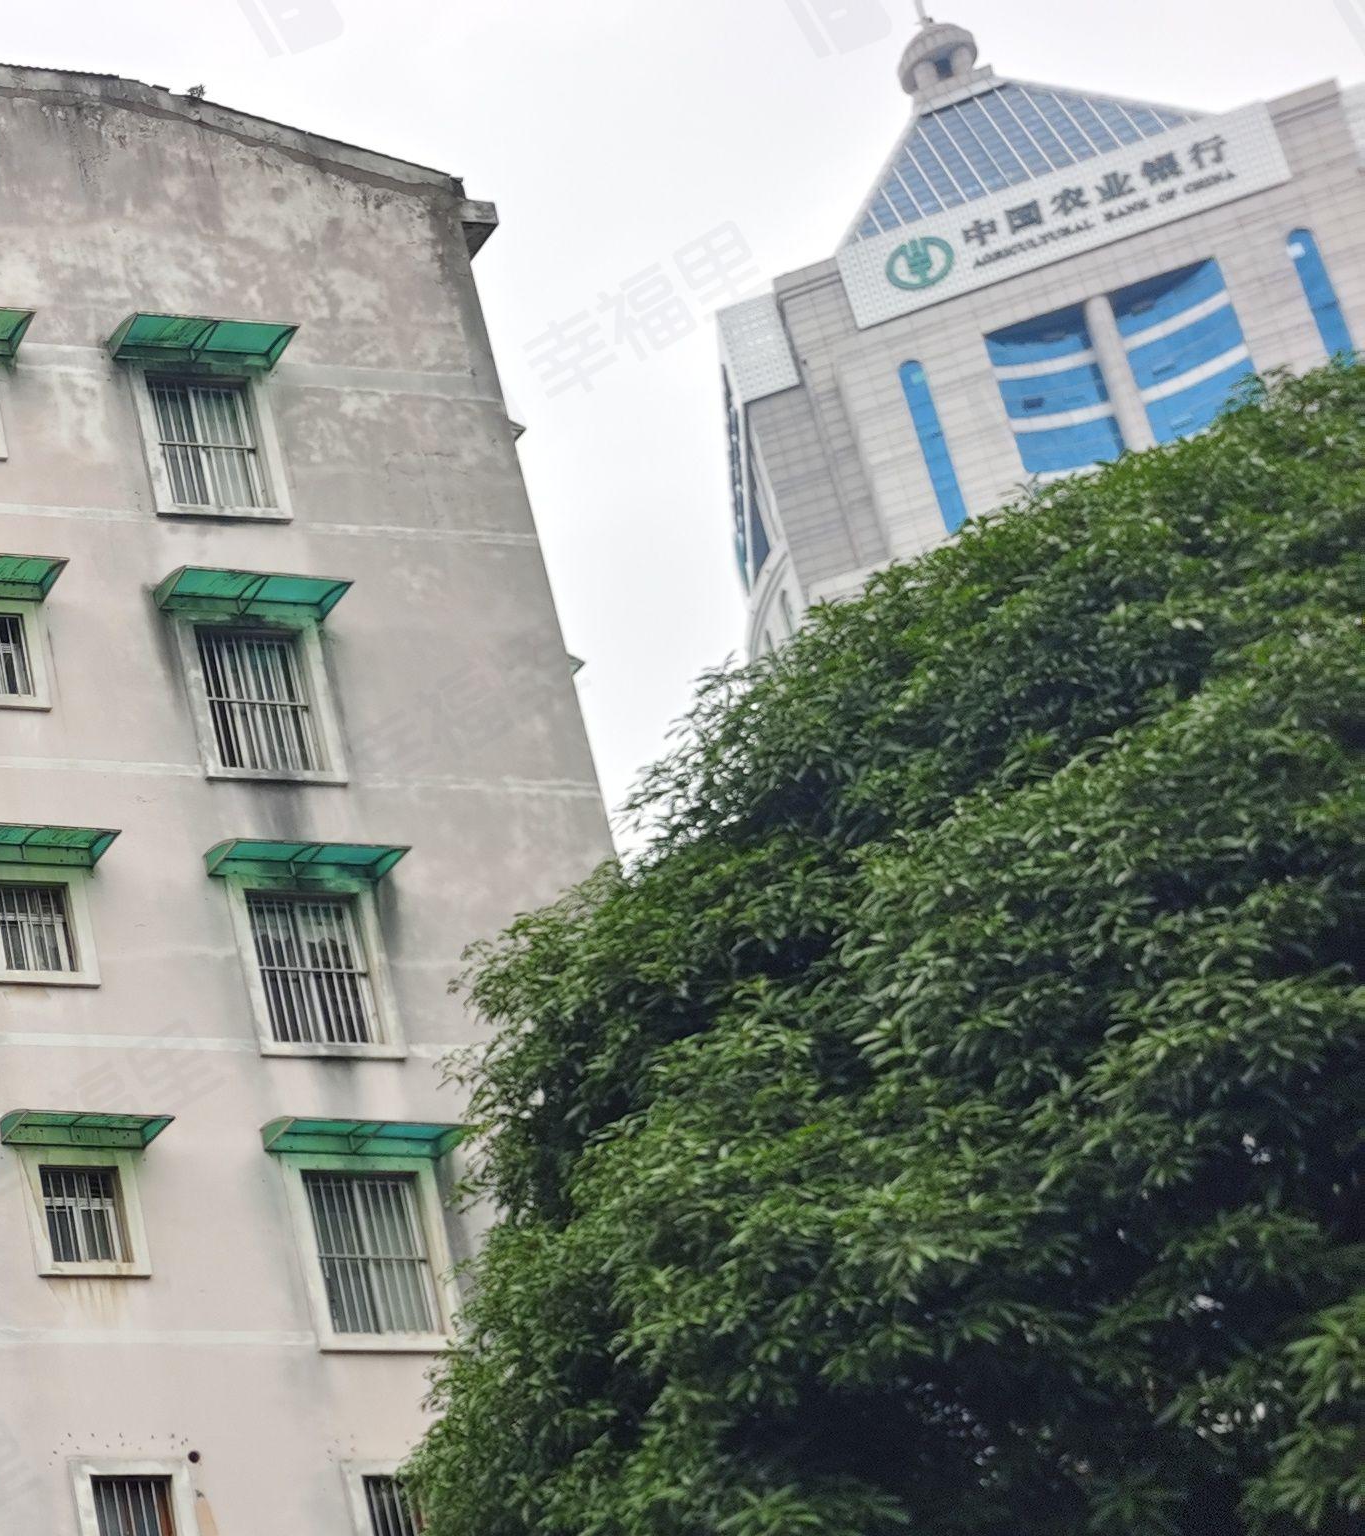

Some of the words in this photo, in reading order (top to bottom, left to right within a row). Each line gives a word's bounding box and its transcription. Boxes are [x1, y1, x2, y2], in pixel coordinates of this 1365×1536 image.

[961, 135, 1227, 246] 中国农业银行
[972, 220, 1095, 268] AGRICULTURAL
[1103, 198, 1151, 223] BANK
[1157, 188, 1178, 204] OF
[1183, 169, 1236, 195] CHINA
